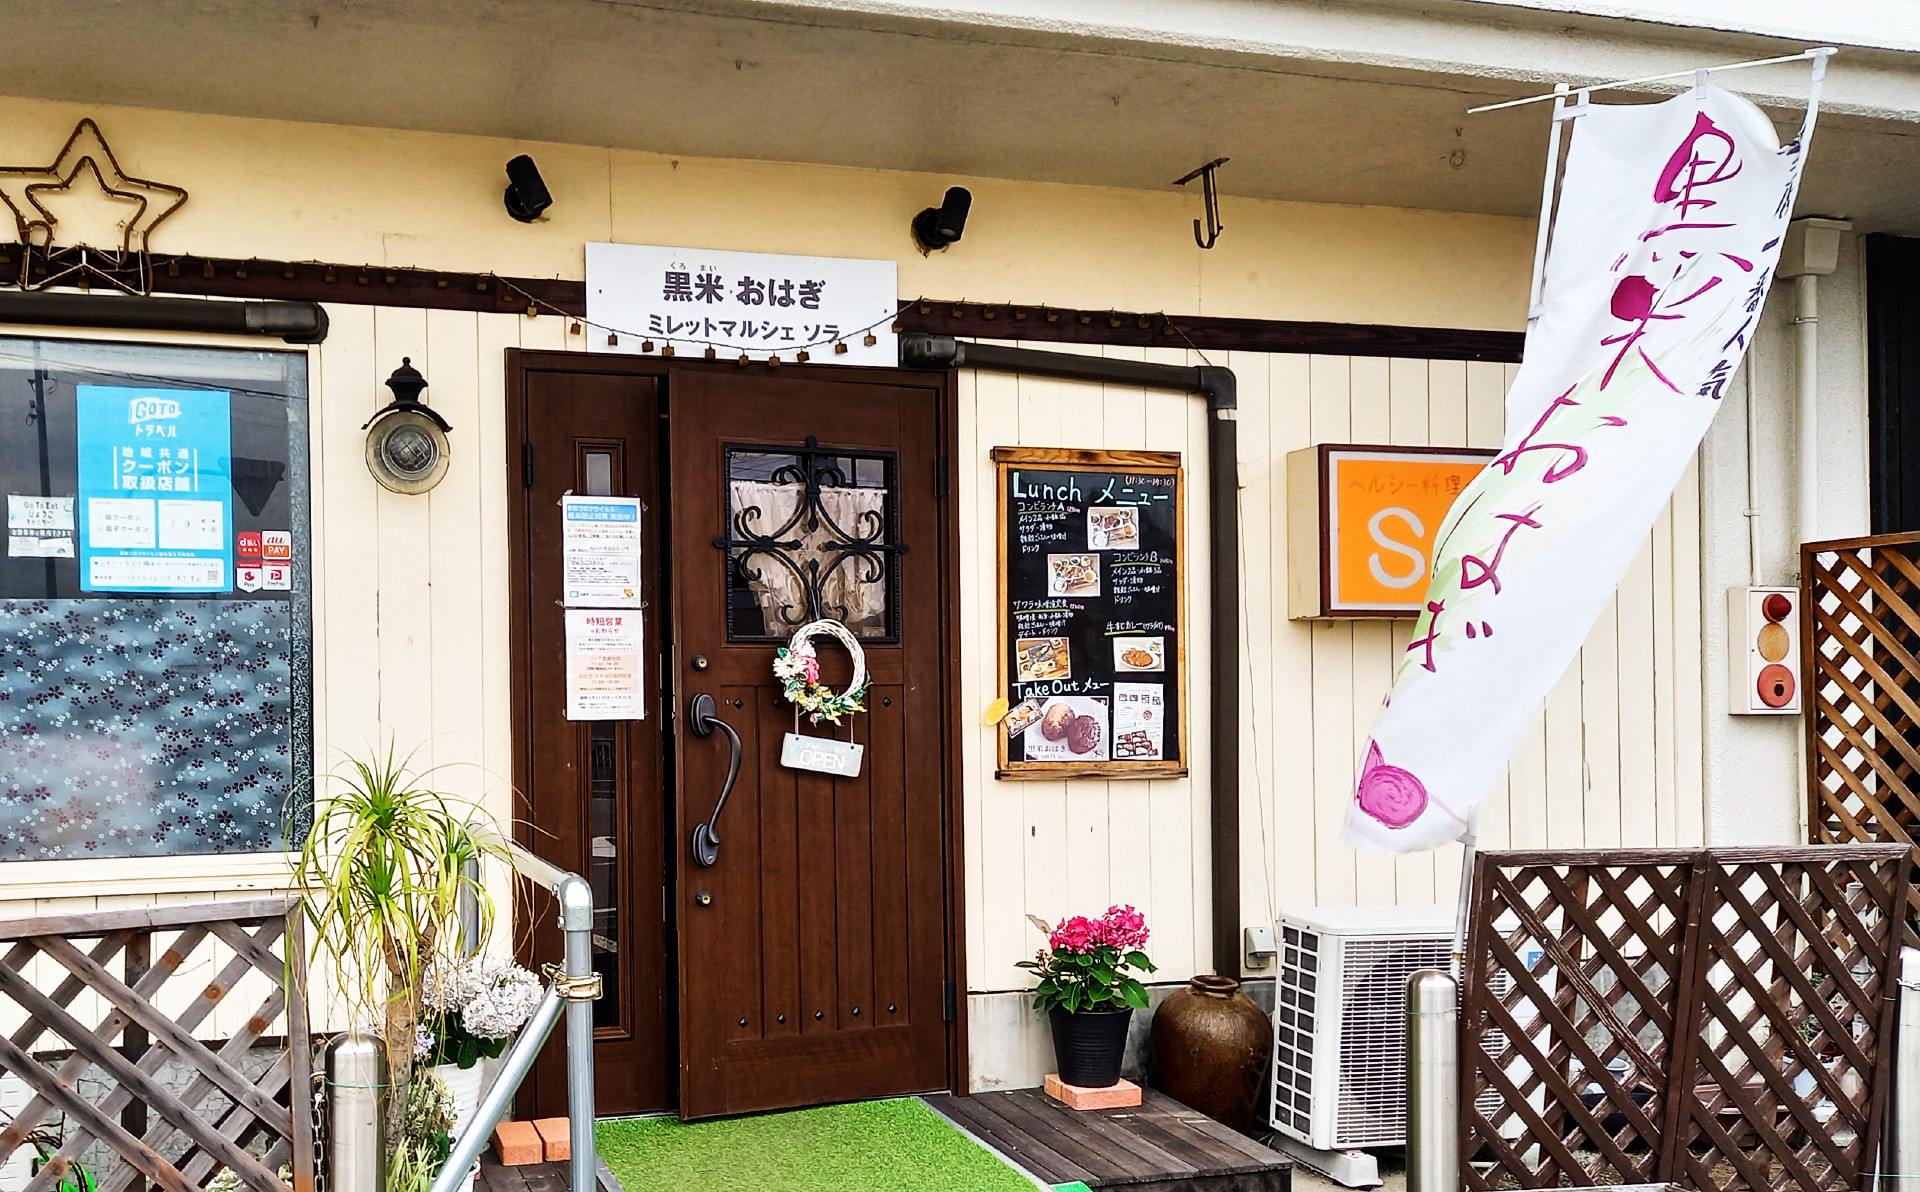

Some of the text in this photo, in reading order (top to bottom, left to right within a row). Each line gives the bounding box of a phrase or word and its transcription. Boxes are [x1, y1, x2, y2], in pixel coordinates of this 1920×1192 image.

[663, 271, 826, 310] 黒米 おはぎ
[648, 313, 841, 344] ミレットマルシェ ソラ
[135, 424, 178, 438] トラベル
[122, 446, 190, 460] 地域共通
[122, 459, 190, 474] クーポン
[122, 475, 191, 492] 取扱店舗
[1012, 472, 1082, 502] Lunch
[1094, 477, 1169, 505] メニュー
[24, 501, 58, 510] Go To Eat
[267, 536, 286, 544] au
[268, 546, 285, 555] PAY
[586, 616, 623, 627] 時短営業
[1011, 682, 1050, 699] Take
[1052, 679, 1079, 694] Out
[800, 749, 846, 771] OPEN
